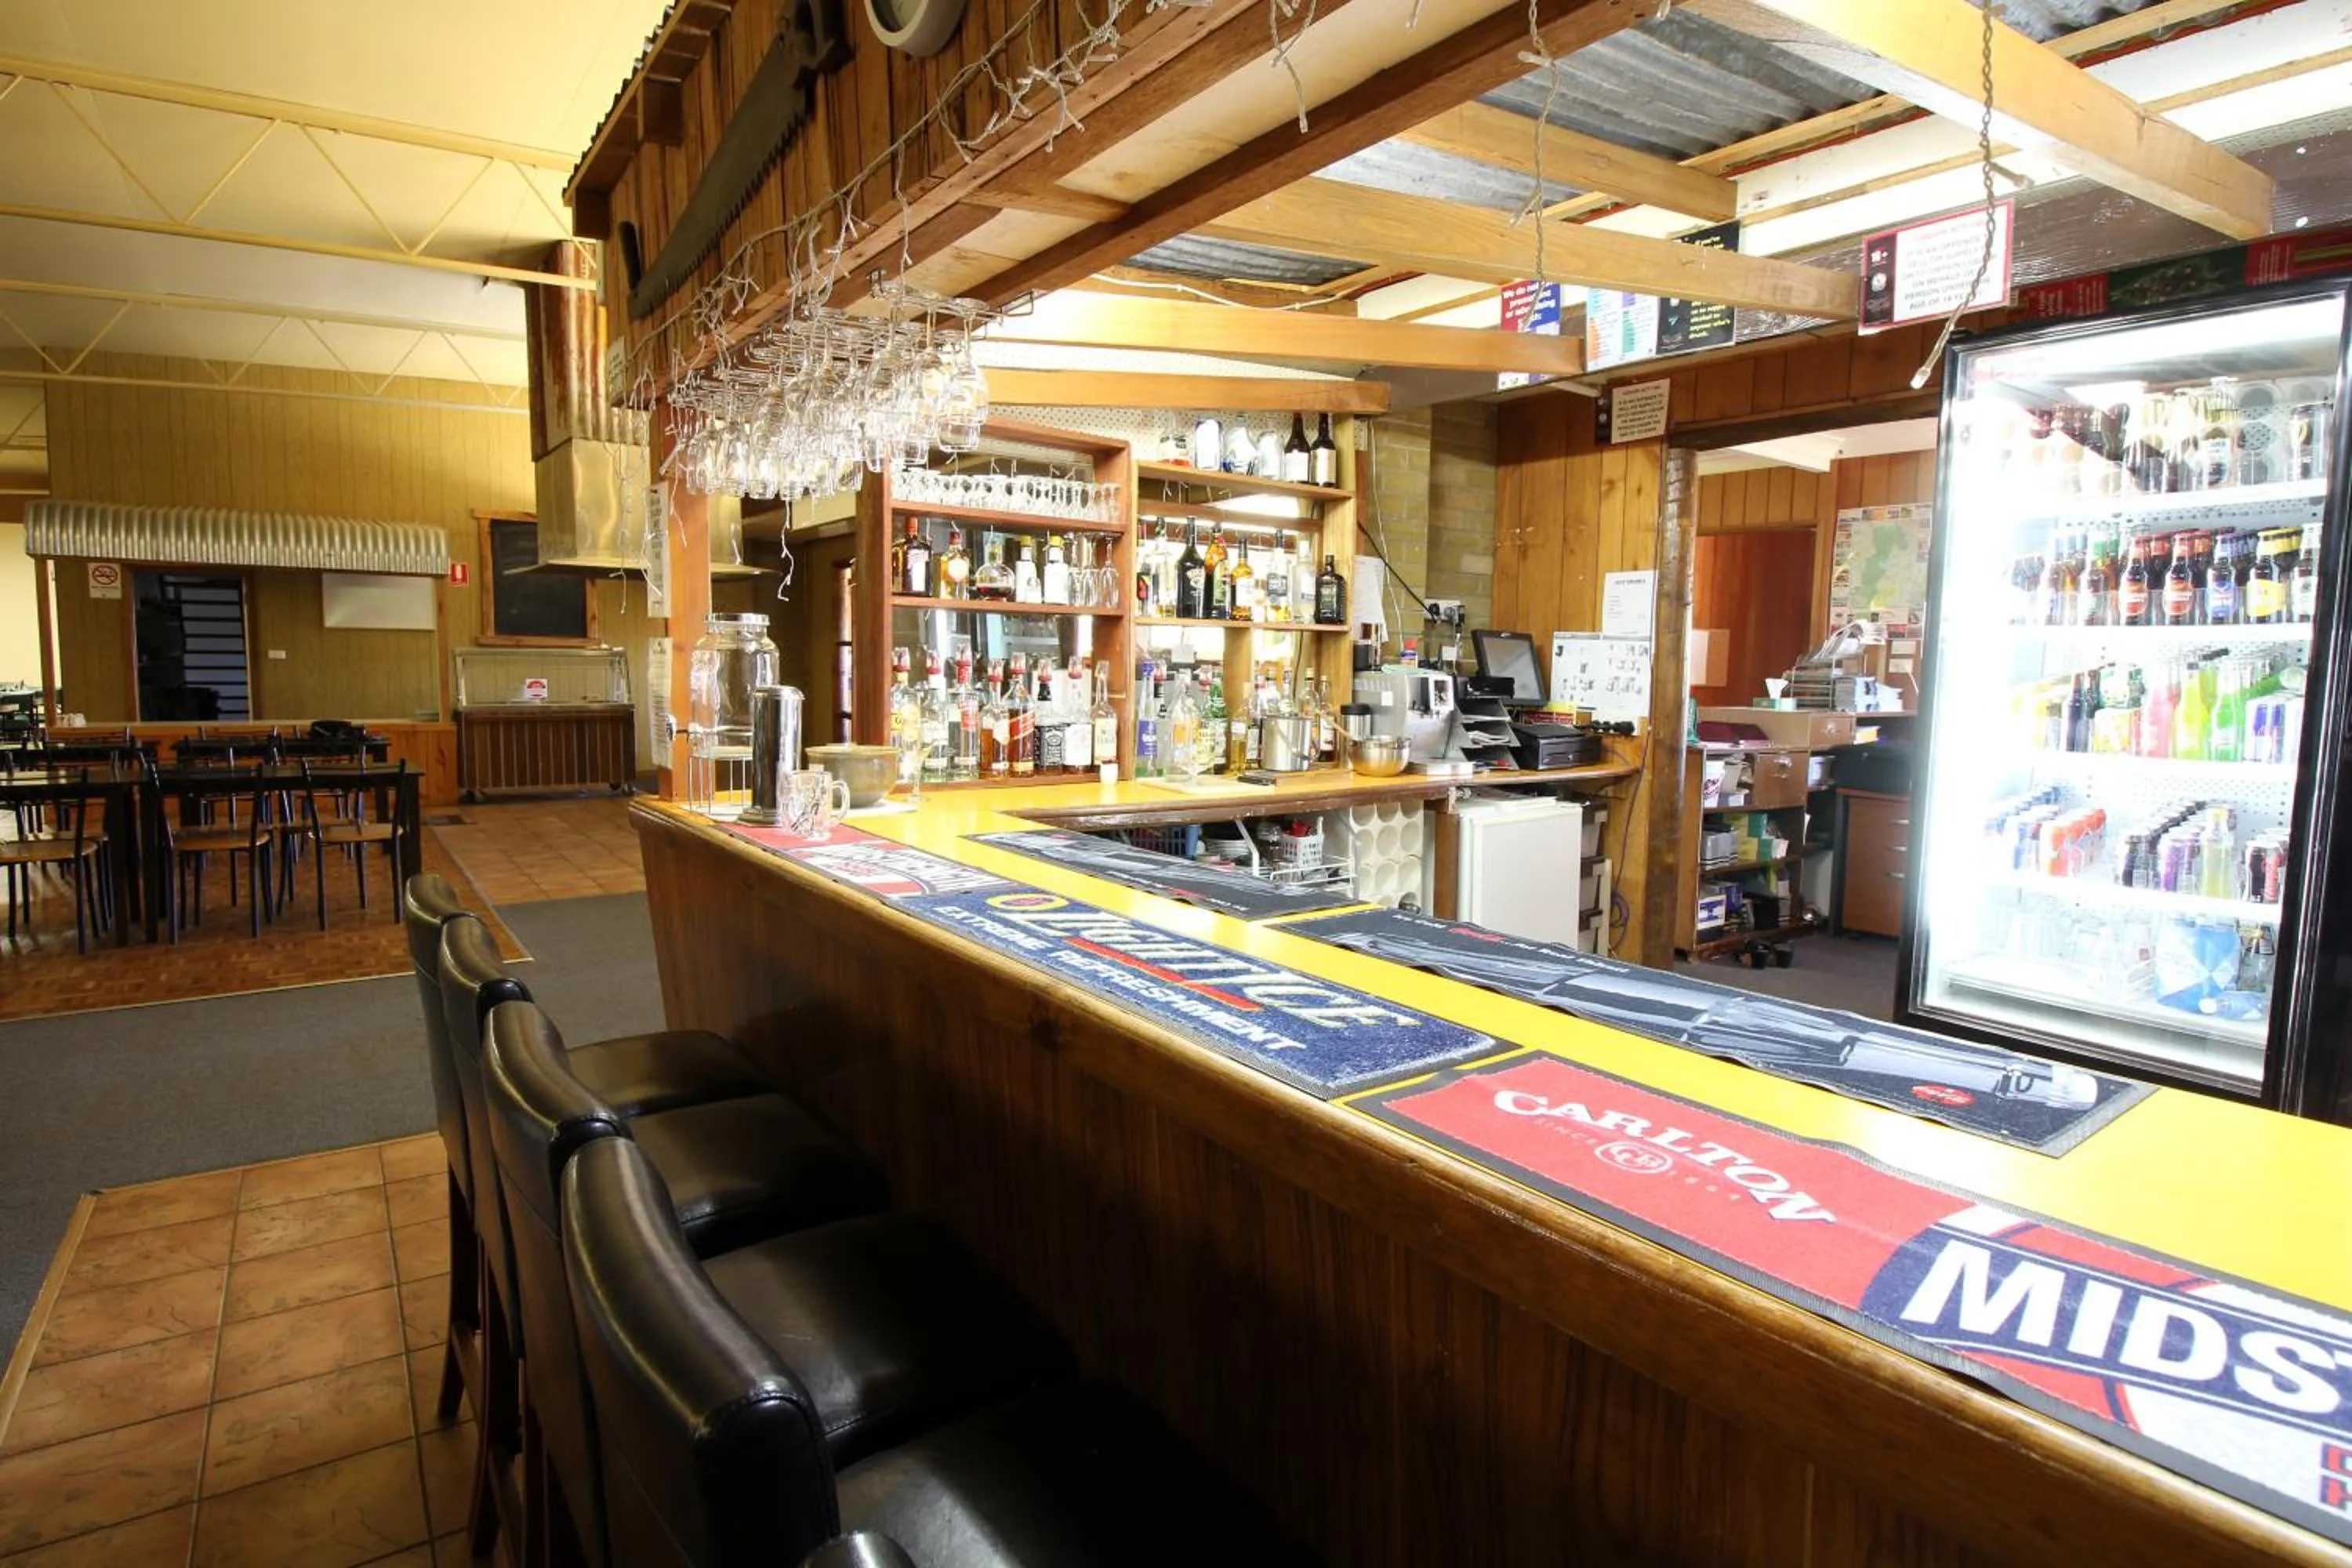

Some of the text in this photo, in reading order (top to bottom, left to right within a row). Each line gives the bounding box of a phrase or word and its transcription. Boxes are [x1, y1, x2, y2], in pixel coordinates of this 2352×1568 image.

[933, 905, 1308, 1051] EXTREME REFRESHMENT
[1494, 1088, 1837, 1225] CARLTON
[1900, 1239, 2352, 1413] MIDS
